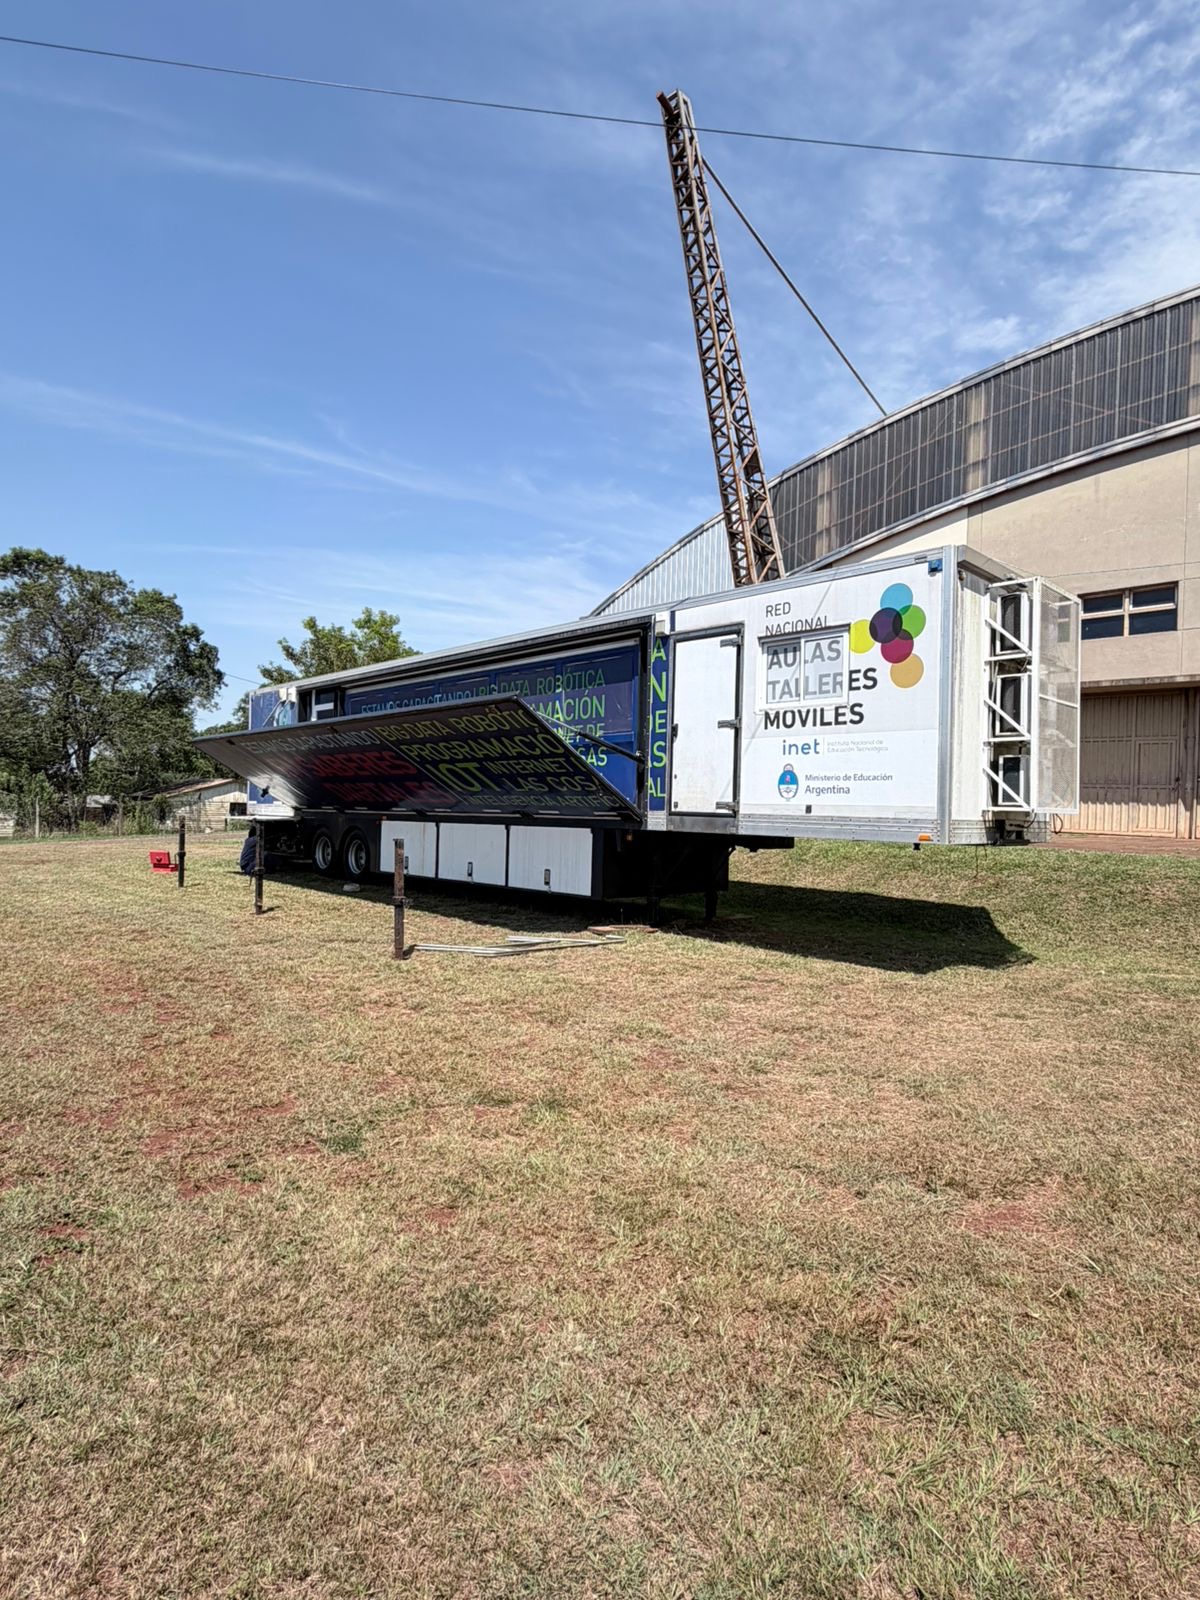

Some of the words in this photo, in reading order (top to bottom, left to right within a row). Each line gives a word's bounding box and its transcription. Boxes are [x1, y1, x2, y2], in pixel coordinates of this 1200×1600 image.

[765, 601, 792, 618] RED
[767, 639, 842, 670] AUAS
[536, 665, 606, 696] ROBÓTICA
[763, 702, 865, 730] MOVILES
[289, 730, 381, 751] CAPACITANDO
[377, 726, 410, 741] BIG
[407, 720, 451, 739] DATA
[782, 738, 820, 755] inet
[483, 757, 575, 775] INTERNET
[424, 762, 500, 792] IOT
[502, 775, 549, 792] LAS
[853, 773, 893, 781] Educación
[805, 785, 850, 796] Argentina
